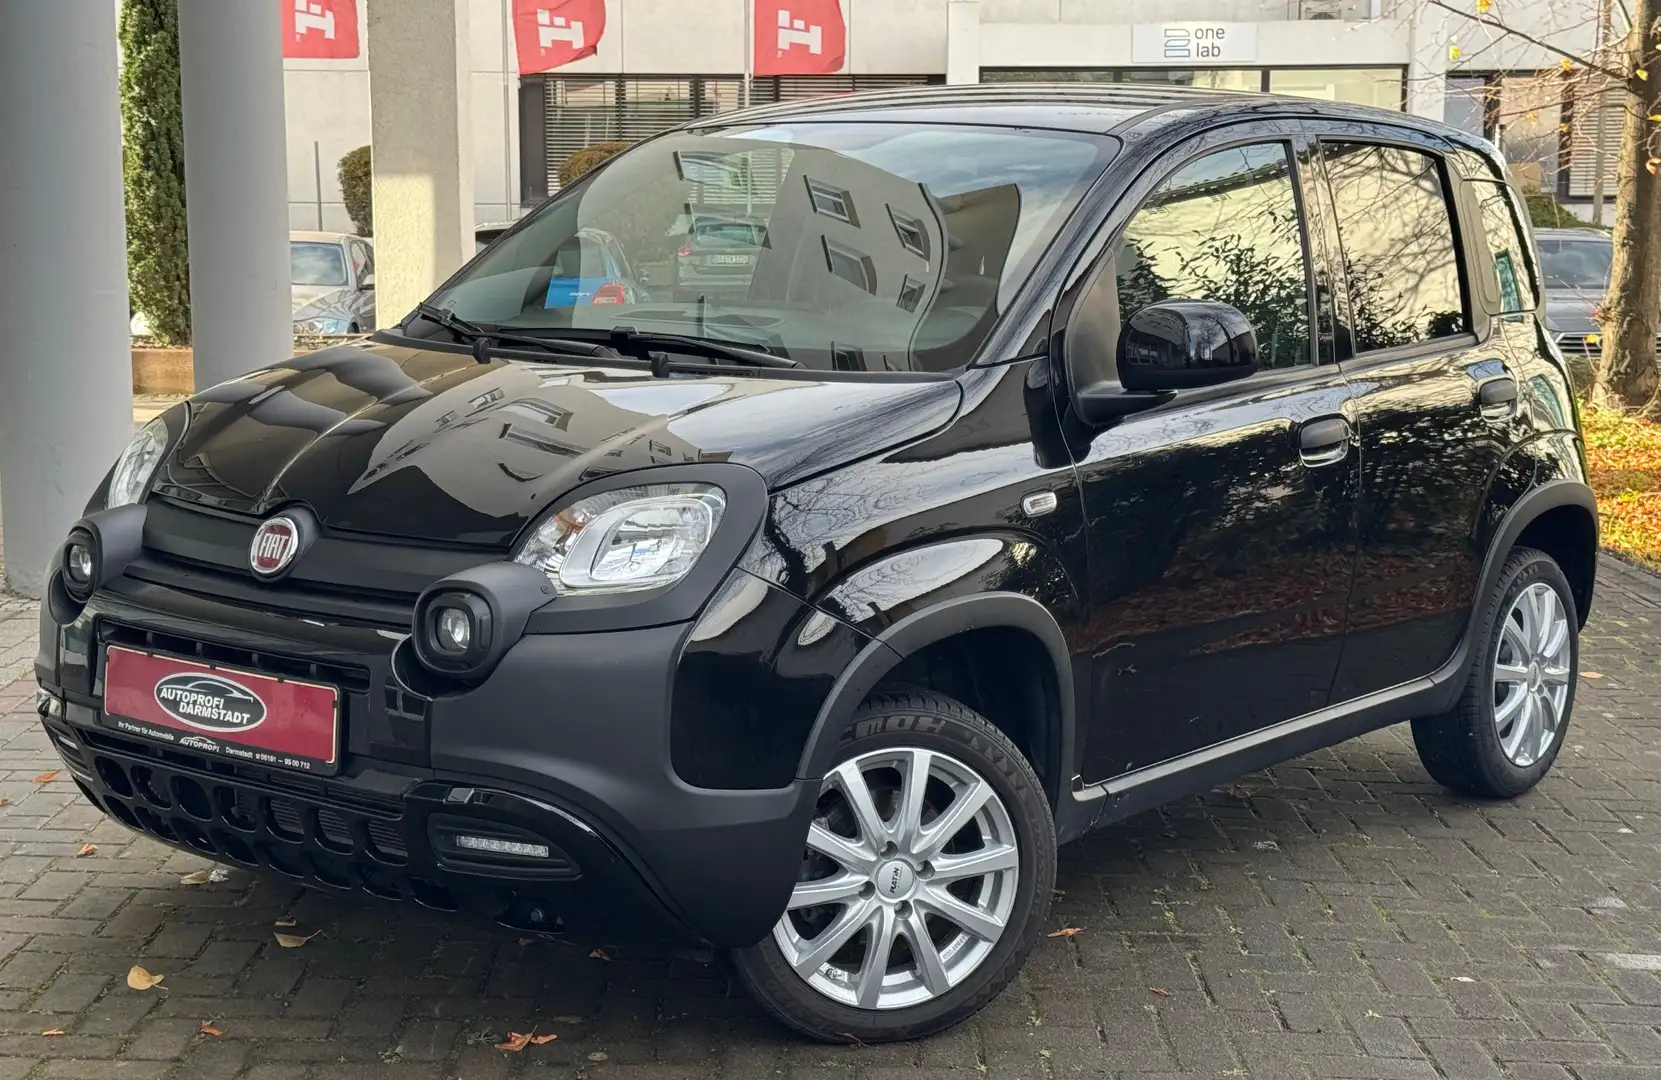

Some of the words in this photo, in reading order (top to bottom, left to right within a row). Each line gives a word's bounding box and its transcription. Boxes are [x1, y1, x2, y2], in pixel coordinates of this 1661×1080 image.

[1195, 28, 1225, 40] one
[1196, 42, 1221, 58] lab
[259, 533, 289, 559] FIAT
[160, 688, 224, 708] AUTOPROFI
[179, 702, 250, 724] DARMSTADT
[125, 722, 141, 733] Partner
[148, 729, 174, 741] Automobile
[179, 738, 220, 752] AUTOPROFI
[226, 746, 253, 759] Darmstadt
